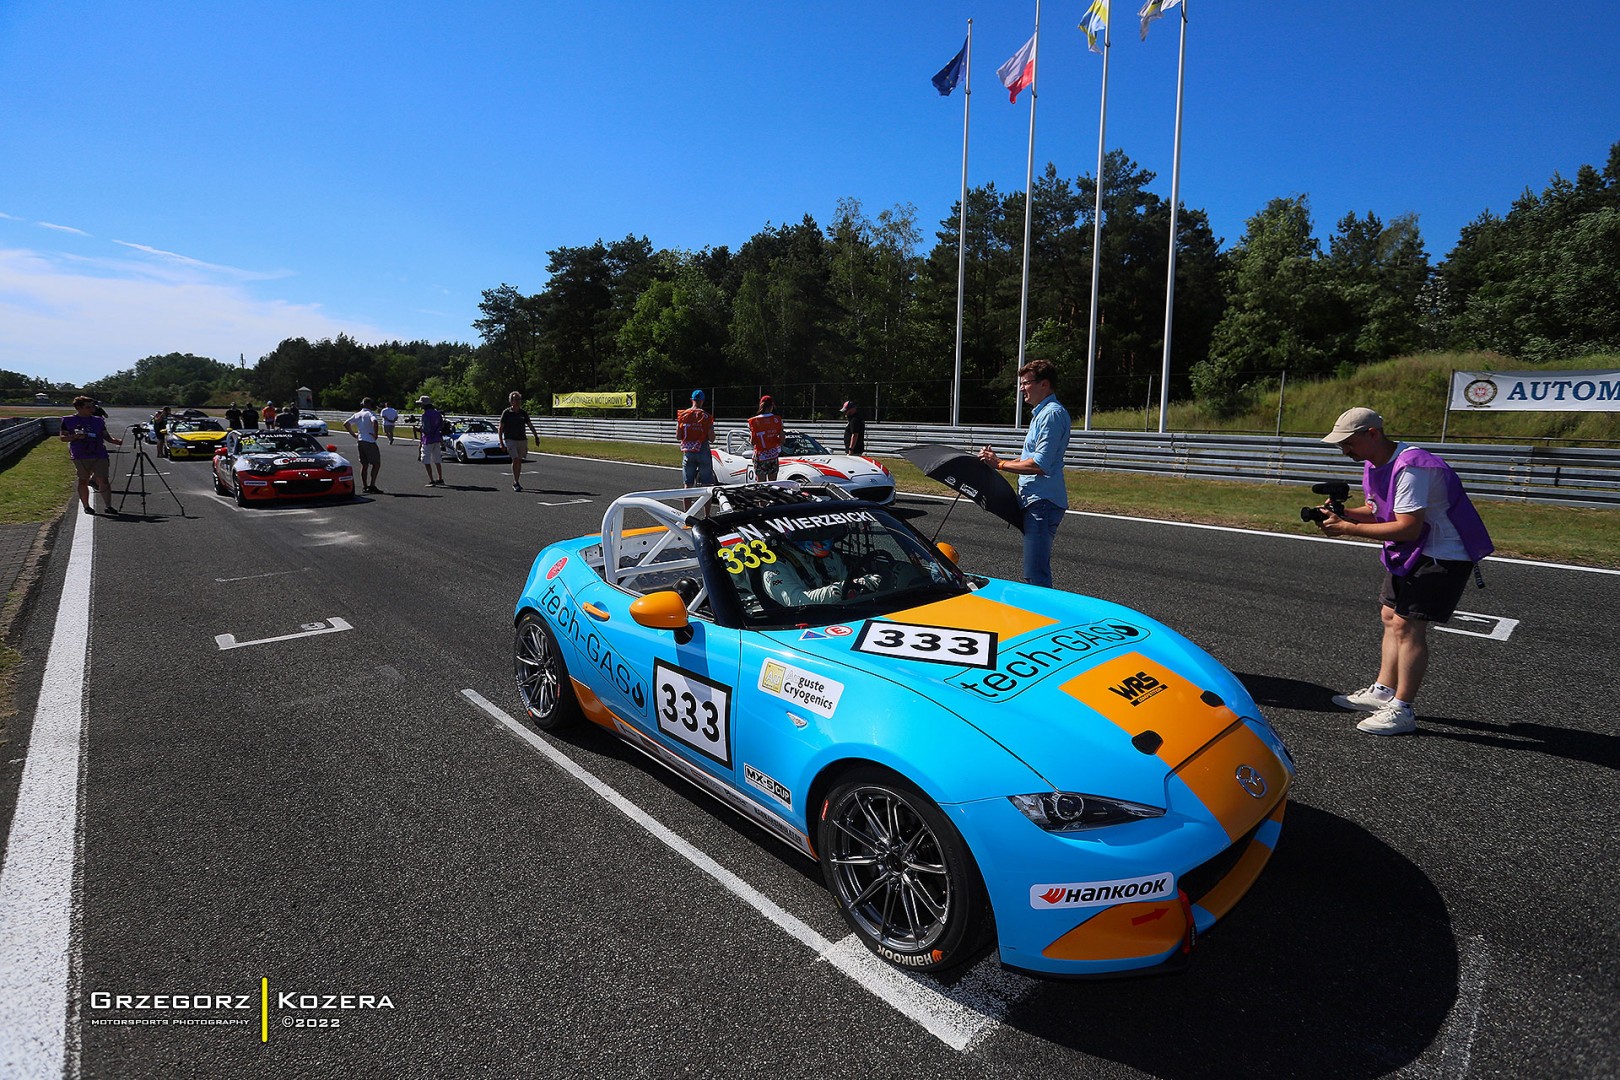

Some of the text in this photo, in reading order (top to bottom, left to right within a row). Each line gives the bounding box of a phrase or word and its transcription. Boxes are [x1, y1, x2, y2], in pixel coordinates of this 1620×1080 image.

[737, 510, 878, 542] N. WIERZBICKI
[717, 539, 777, 575] 333
[540, 584, 631, 696] tech-GAS
[872, 629, 980, 657] 333
[960, 623, 1127, 698] tech-GAS
[783, 681, 834, 711] Cryogenics
[1107, 671, 1160, 701] WRS
[660, 682, 720, 743] 333
[747, 767, 773, 790] MX-5
[775, 784, 790, 800] CUP
